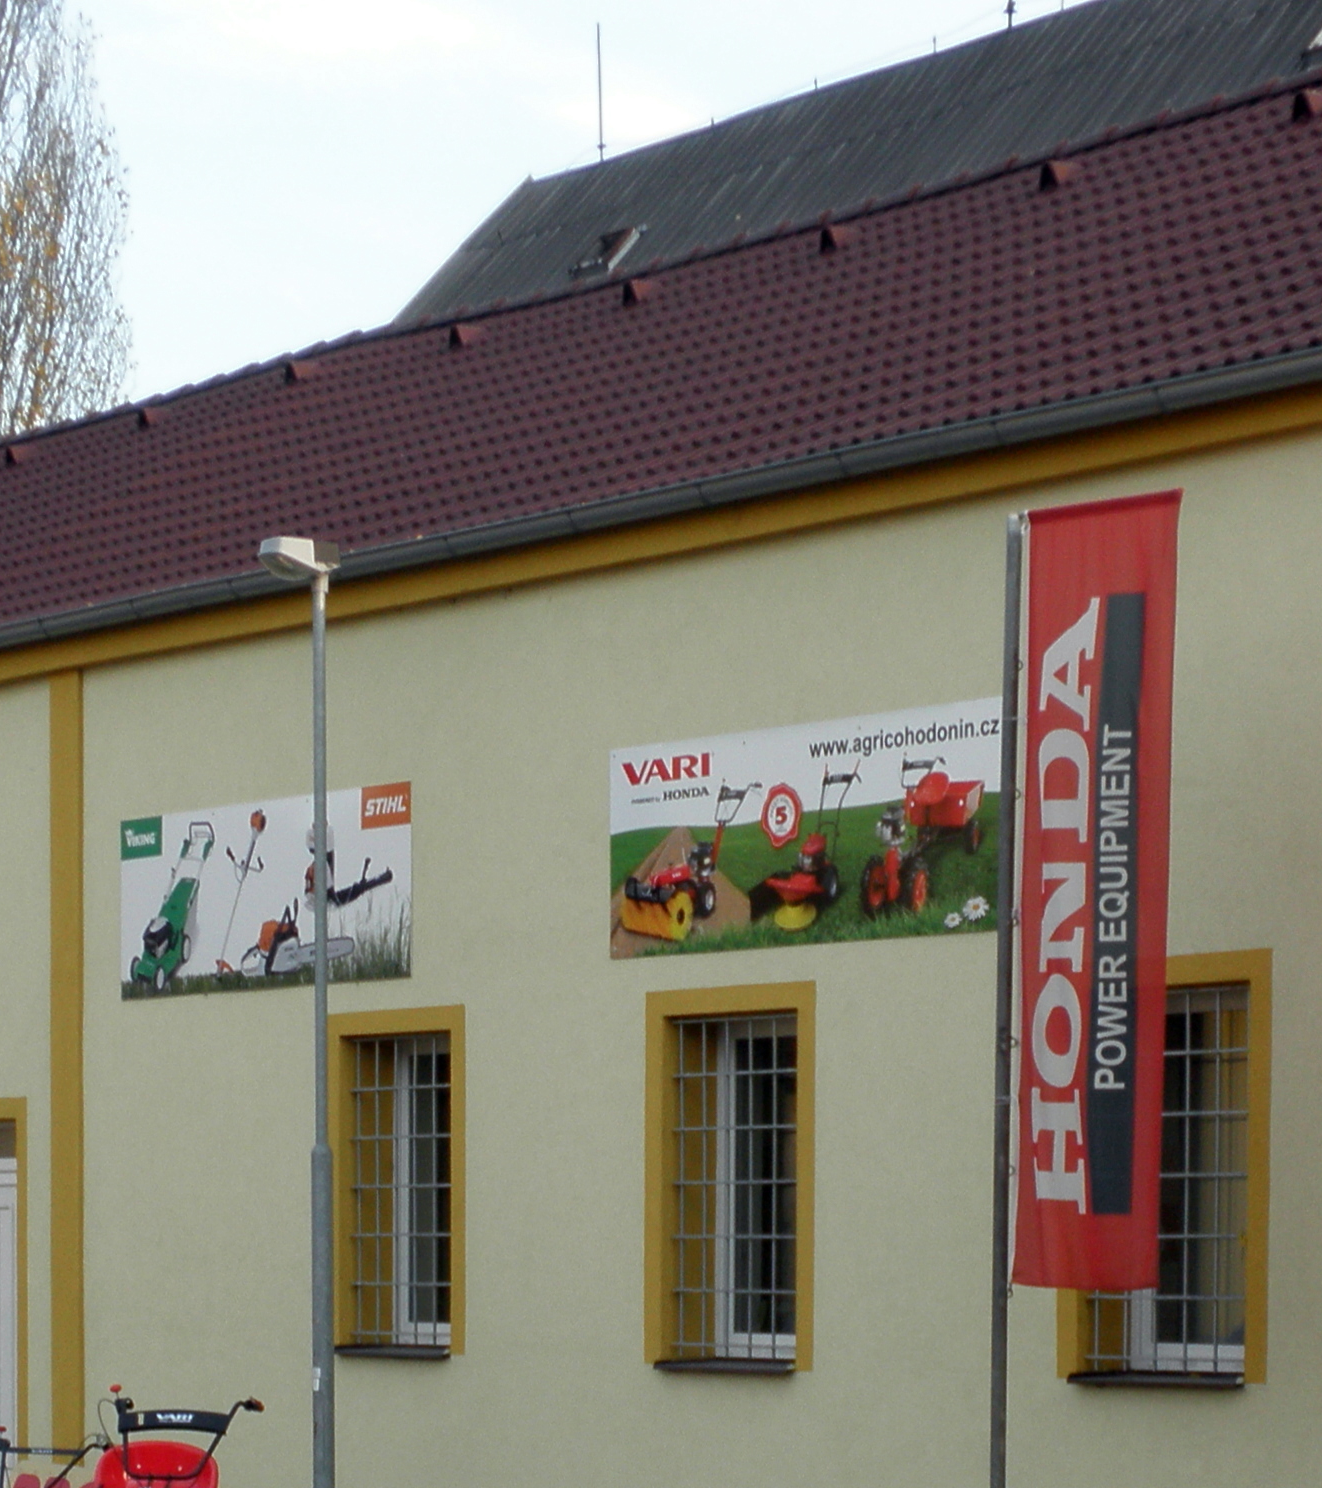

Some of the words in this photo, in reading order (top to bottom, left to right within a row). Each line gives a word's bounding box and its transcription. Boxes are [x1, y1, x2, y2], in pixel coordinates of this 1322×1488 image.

[809, 718, 1000, 758] www.agricohodonin.cz
[621, 753, 710, 786] VARI
[365, 795, 406, 817] STIHL
[662, 786, 710, 801] HONDA
[775, 806, 787, 825] 5
[125, 829, 156, 847] VIKING
[1099, 723, 1132, 943] EQUIPMENT
[1032, 598, 1100, 1215] HONDA
[1094, 953, 1127, 1090] POWER
